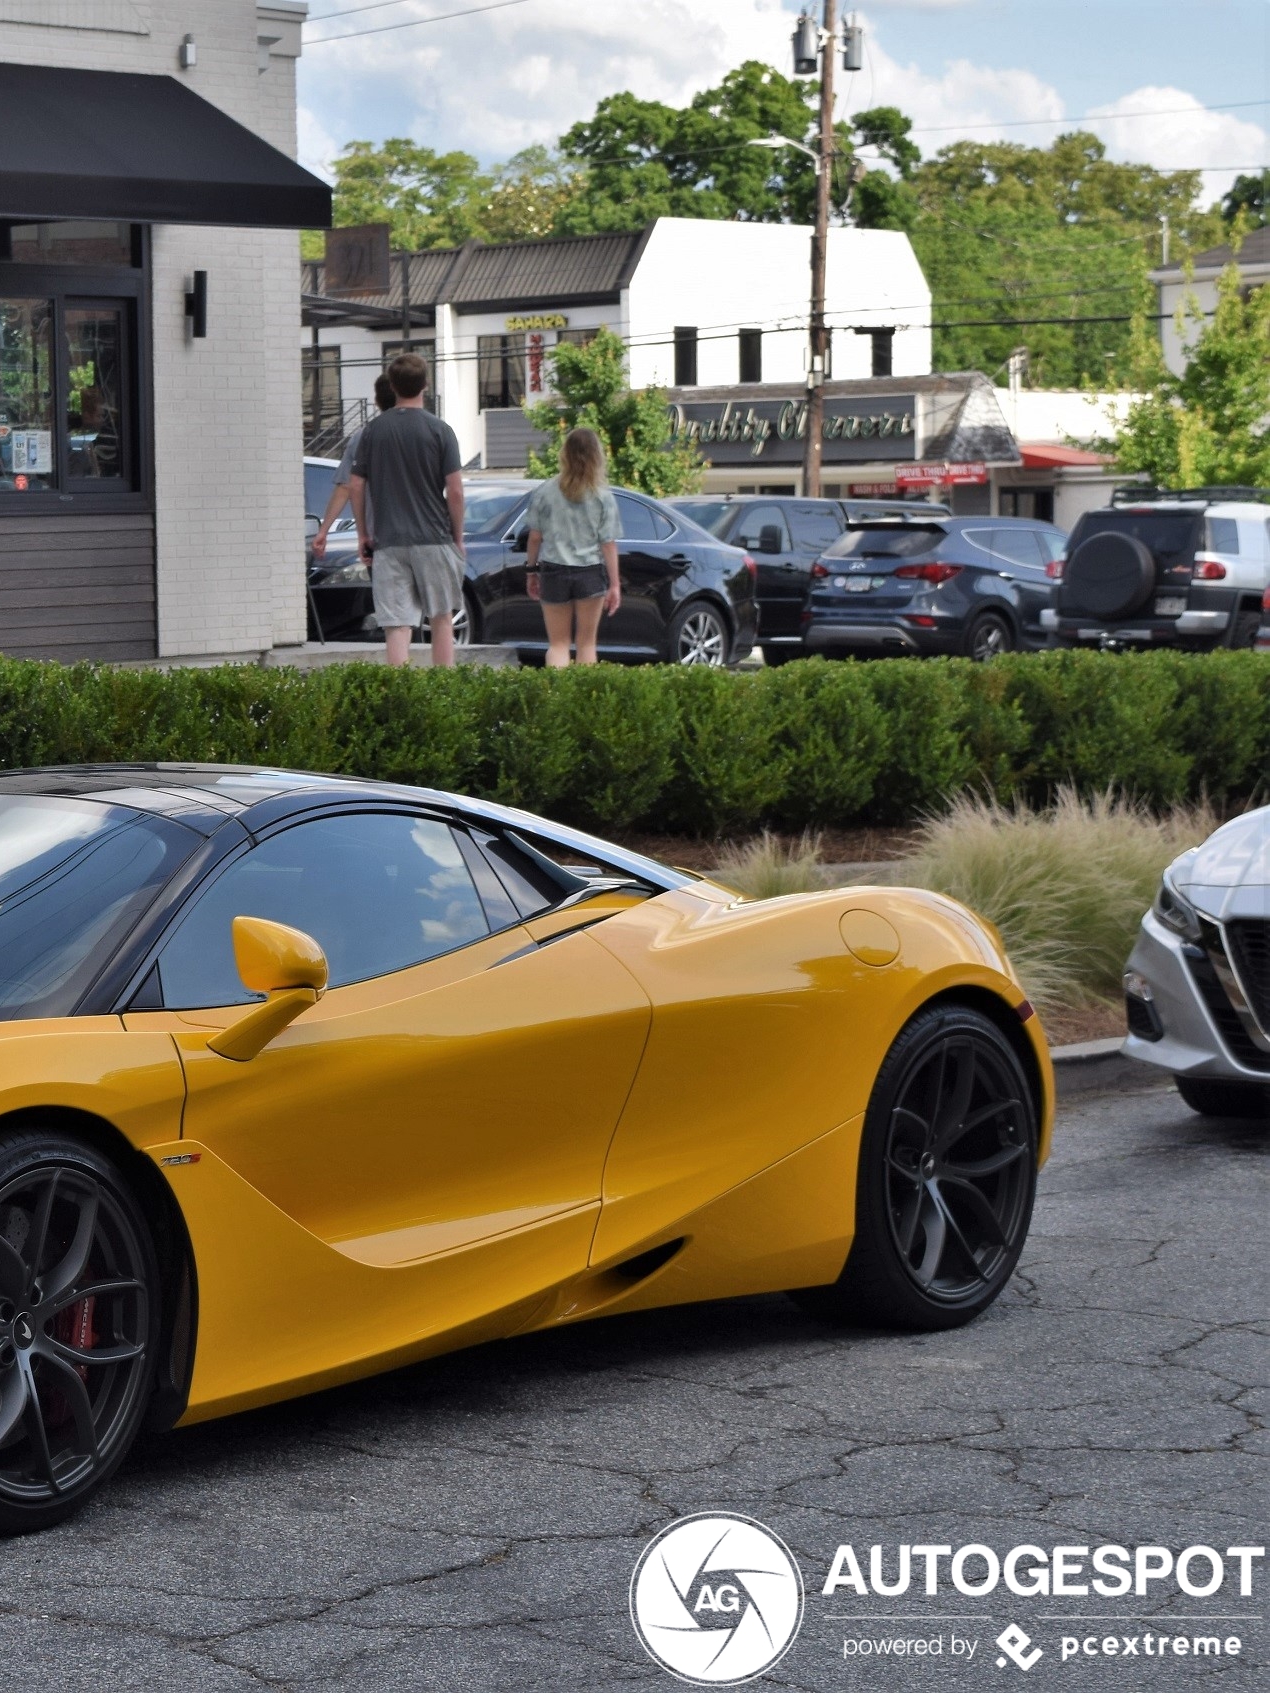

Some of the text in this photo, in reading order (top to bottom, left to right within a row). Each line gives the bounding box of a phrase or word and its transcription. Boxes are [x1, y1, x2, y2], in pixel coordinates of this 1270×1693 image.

[505, 313, 565, 332] SAHARA
[778, 400, 912, 440] Claners
[896, 466, 946, 478] DRIVE THRU
[160, 1153, 202, 1167] 720S
